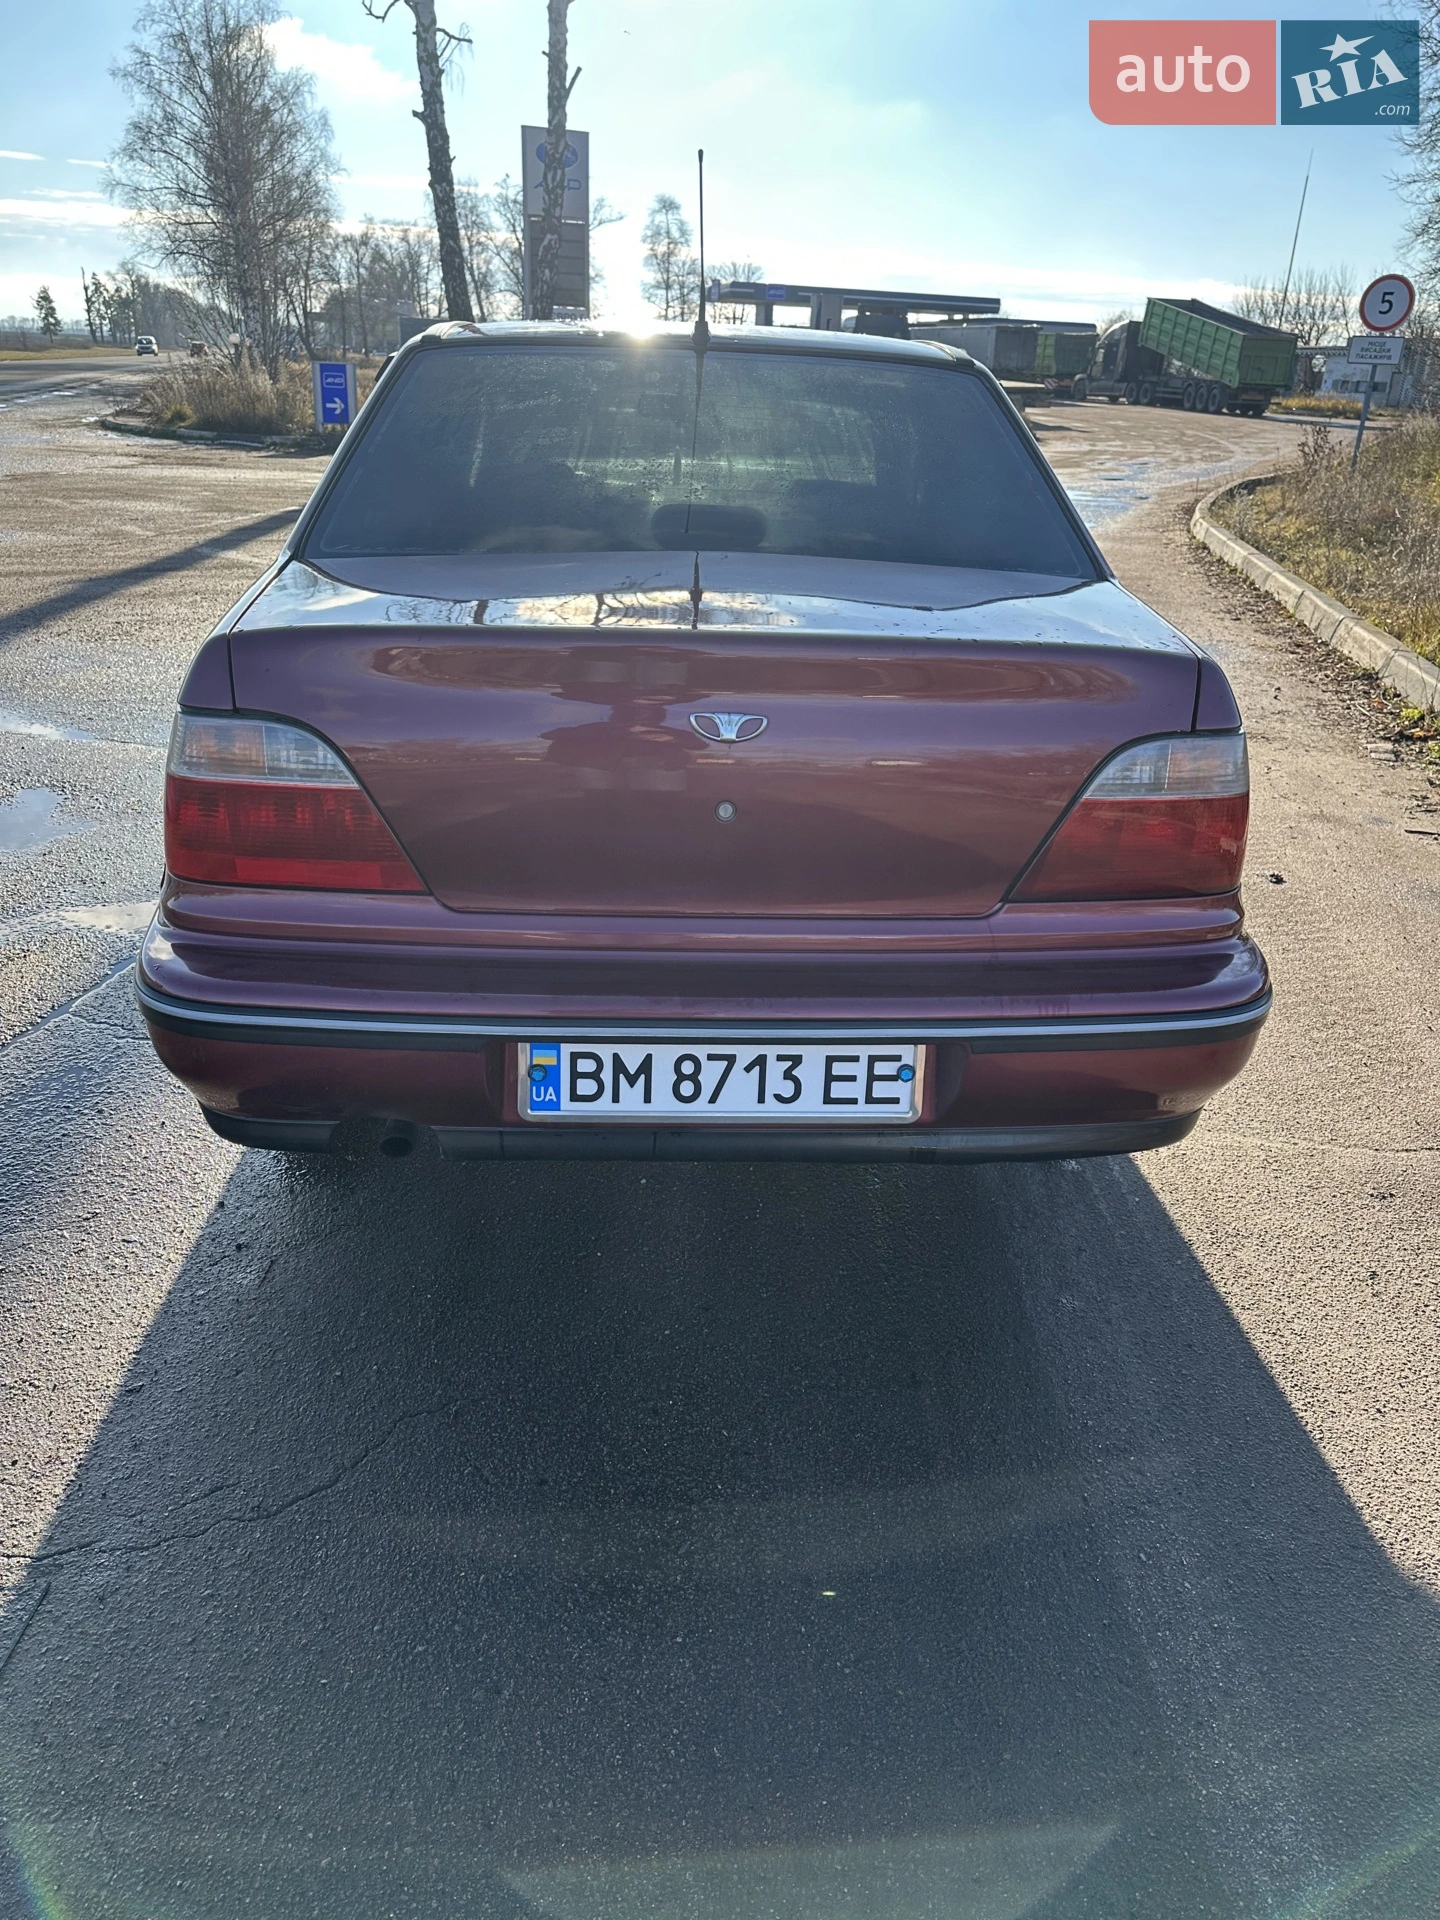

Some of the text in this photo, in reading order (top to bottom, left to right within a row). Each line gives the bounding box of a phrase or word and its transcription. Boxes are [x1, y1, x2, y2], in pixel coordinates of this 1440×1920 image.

[1378, 291, 1395, 315] 5
[569, 1051, 902, 1105] BM 8713 EE
[532, 1086, 557, 1102] UA
